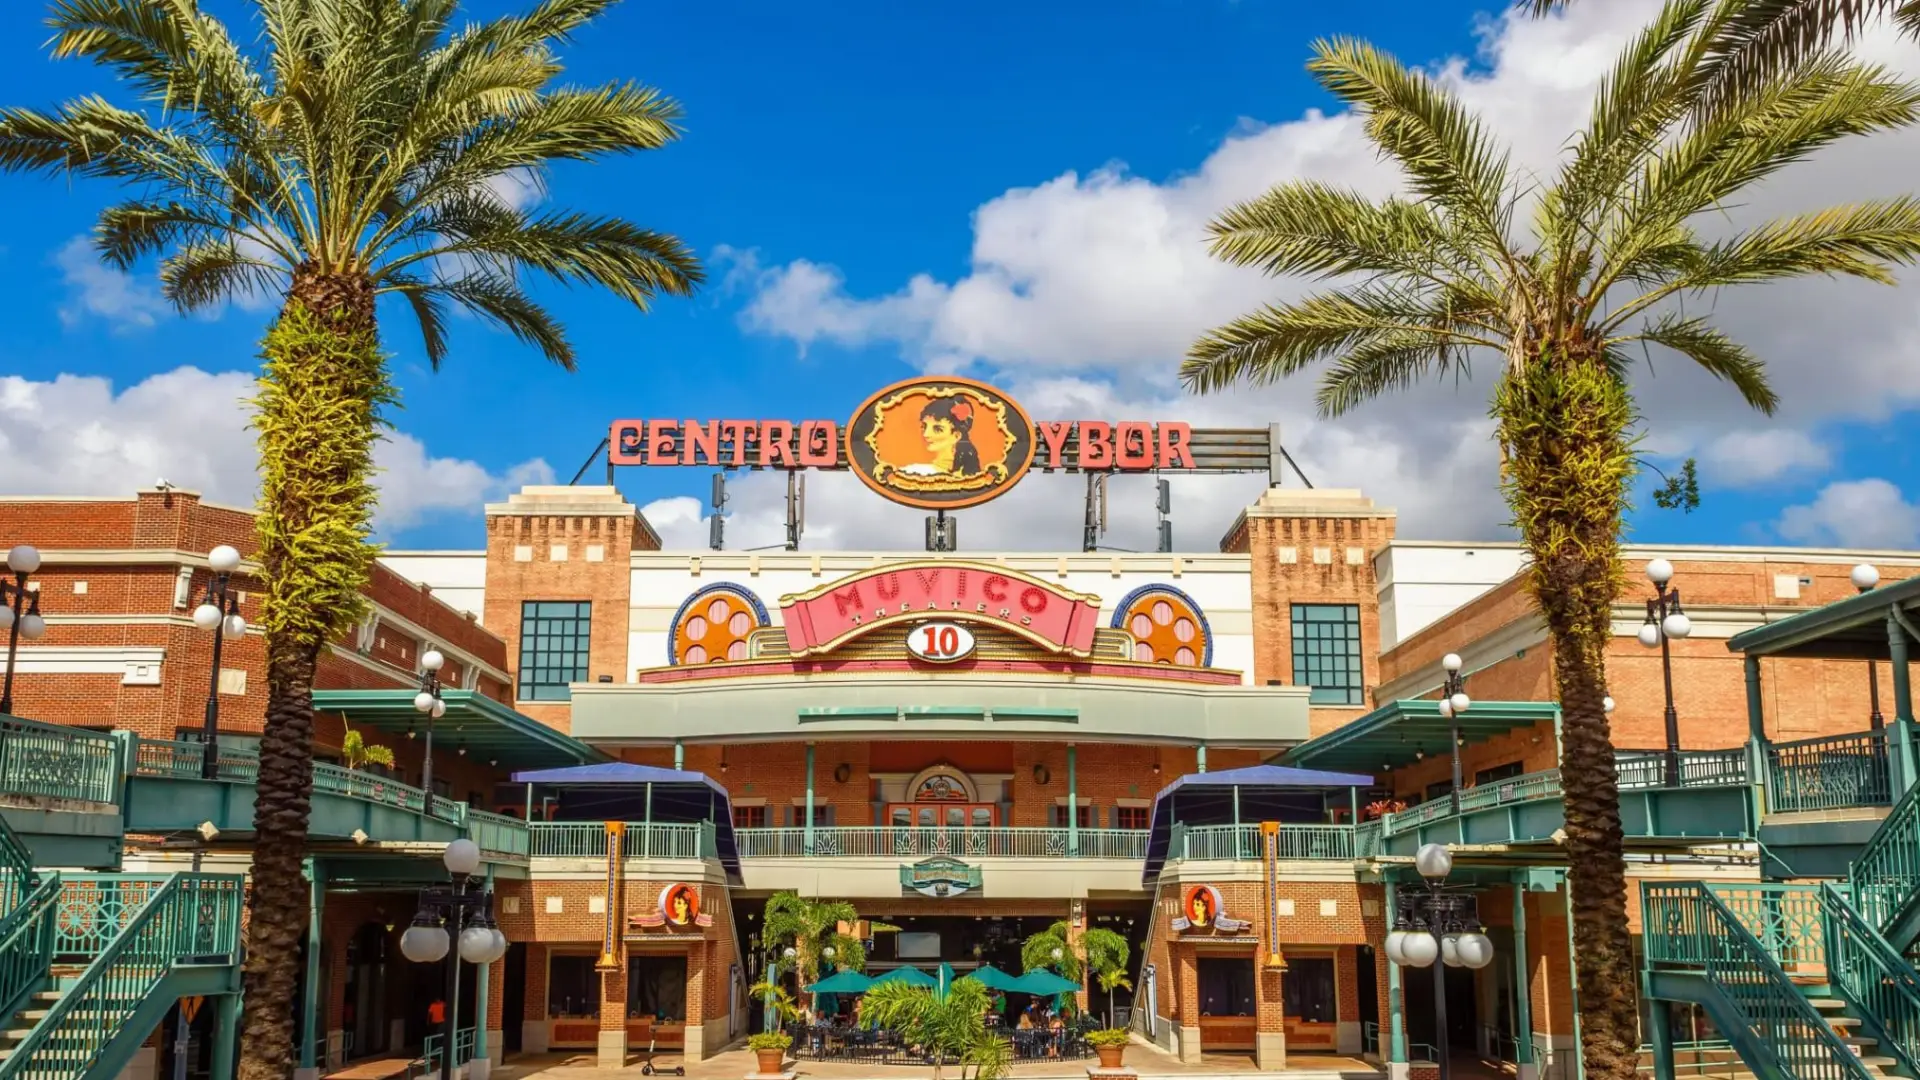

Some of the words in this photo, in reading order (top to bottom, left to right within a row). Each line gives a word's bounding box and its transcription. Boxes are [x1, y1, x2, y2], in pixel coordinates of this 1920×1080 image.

[609, 419, 838, 467] CENTRO
[1037, 421, 1197, 469] YBOR
[833, 570, 1048, 617] MUVICO
[851, 602, 1032, 626] THEATERS
[923, 626, 959, 657] 10
